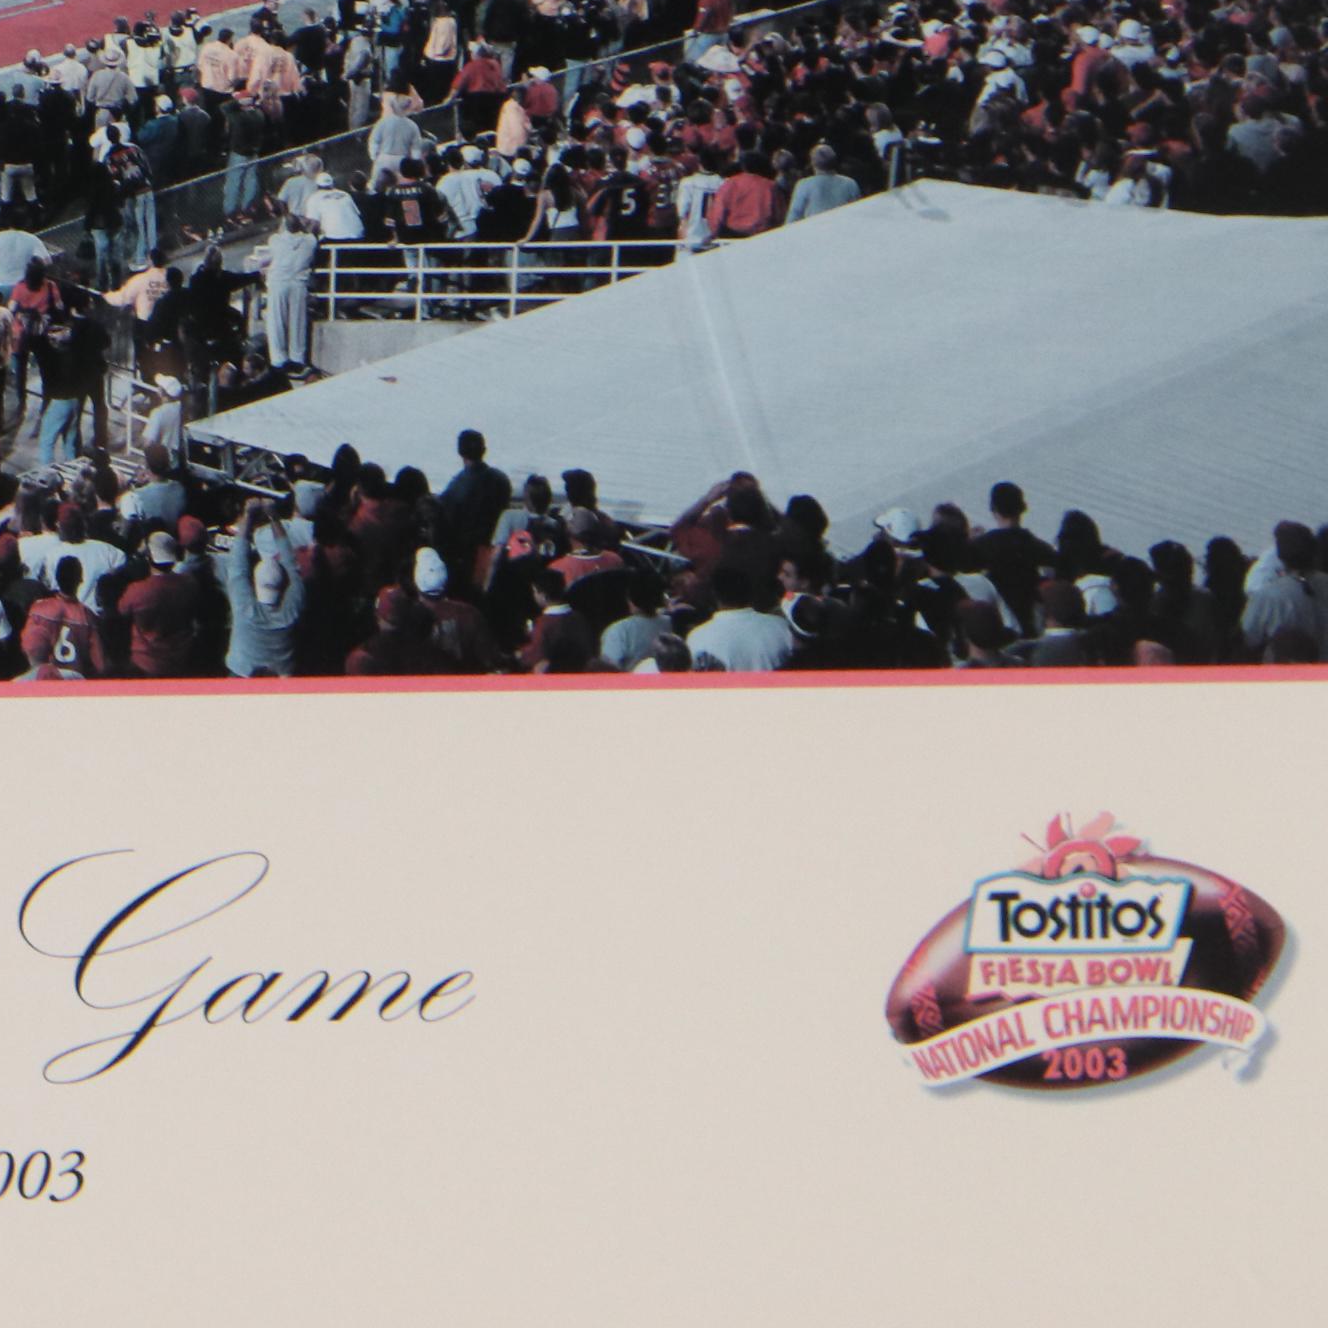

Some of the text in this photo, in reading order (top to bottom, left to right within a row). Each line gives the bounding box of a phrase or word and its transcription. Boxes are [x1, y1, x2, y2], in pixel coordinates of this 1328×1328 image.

[621, 187, 636, 216] 5
[53, 625, 76, 664] 6
[987, 881, 1165, 942] Tostitos
[17, 848, 476, 1085] Game
[979, 957, 1178, 986] FIESTA BOWL
[910, 995, 1255, 1079] NATIONAL CHAMPIONSHIP
[1041, 1047, 1128, 1080] 2003
